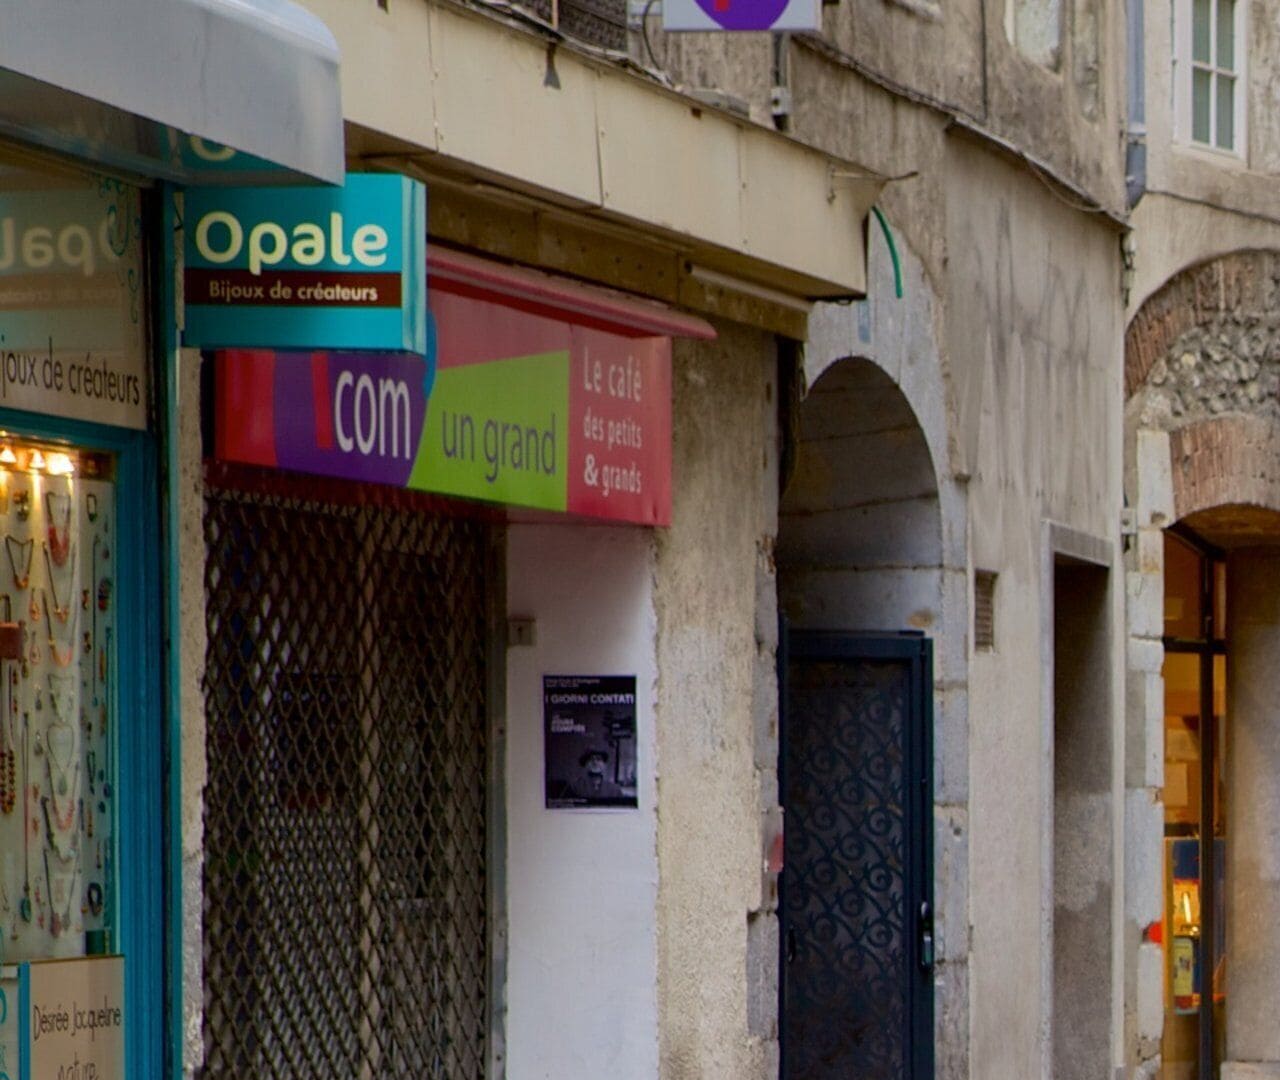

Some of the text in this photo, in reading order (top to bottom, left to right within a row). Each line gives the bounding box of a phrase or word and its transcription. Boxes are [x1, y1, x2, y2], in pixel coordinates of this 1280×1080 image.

[196, 211, 389, 276] Opale
[208, 280, 378, 303] Bijoux de créateurs
[42, 336, 63, 391] de
[68, 351, 140, 405] créateurs
[583, 347, 642, 402] Le café
[334, 370, 556, 484] com un grand
[584, 406, 642, 451] des petits
[584, 454, 642, 497] & grands
[590, 693, 635, 705] CONTATI
